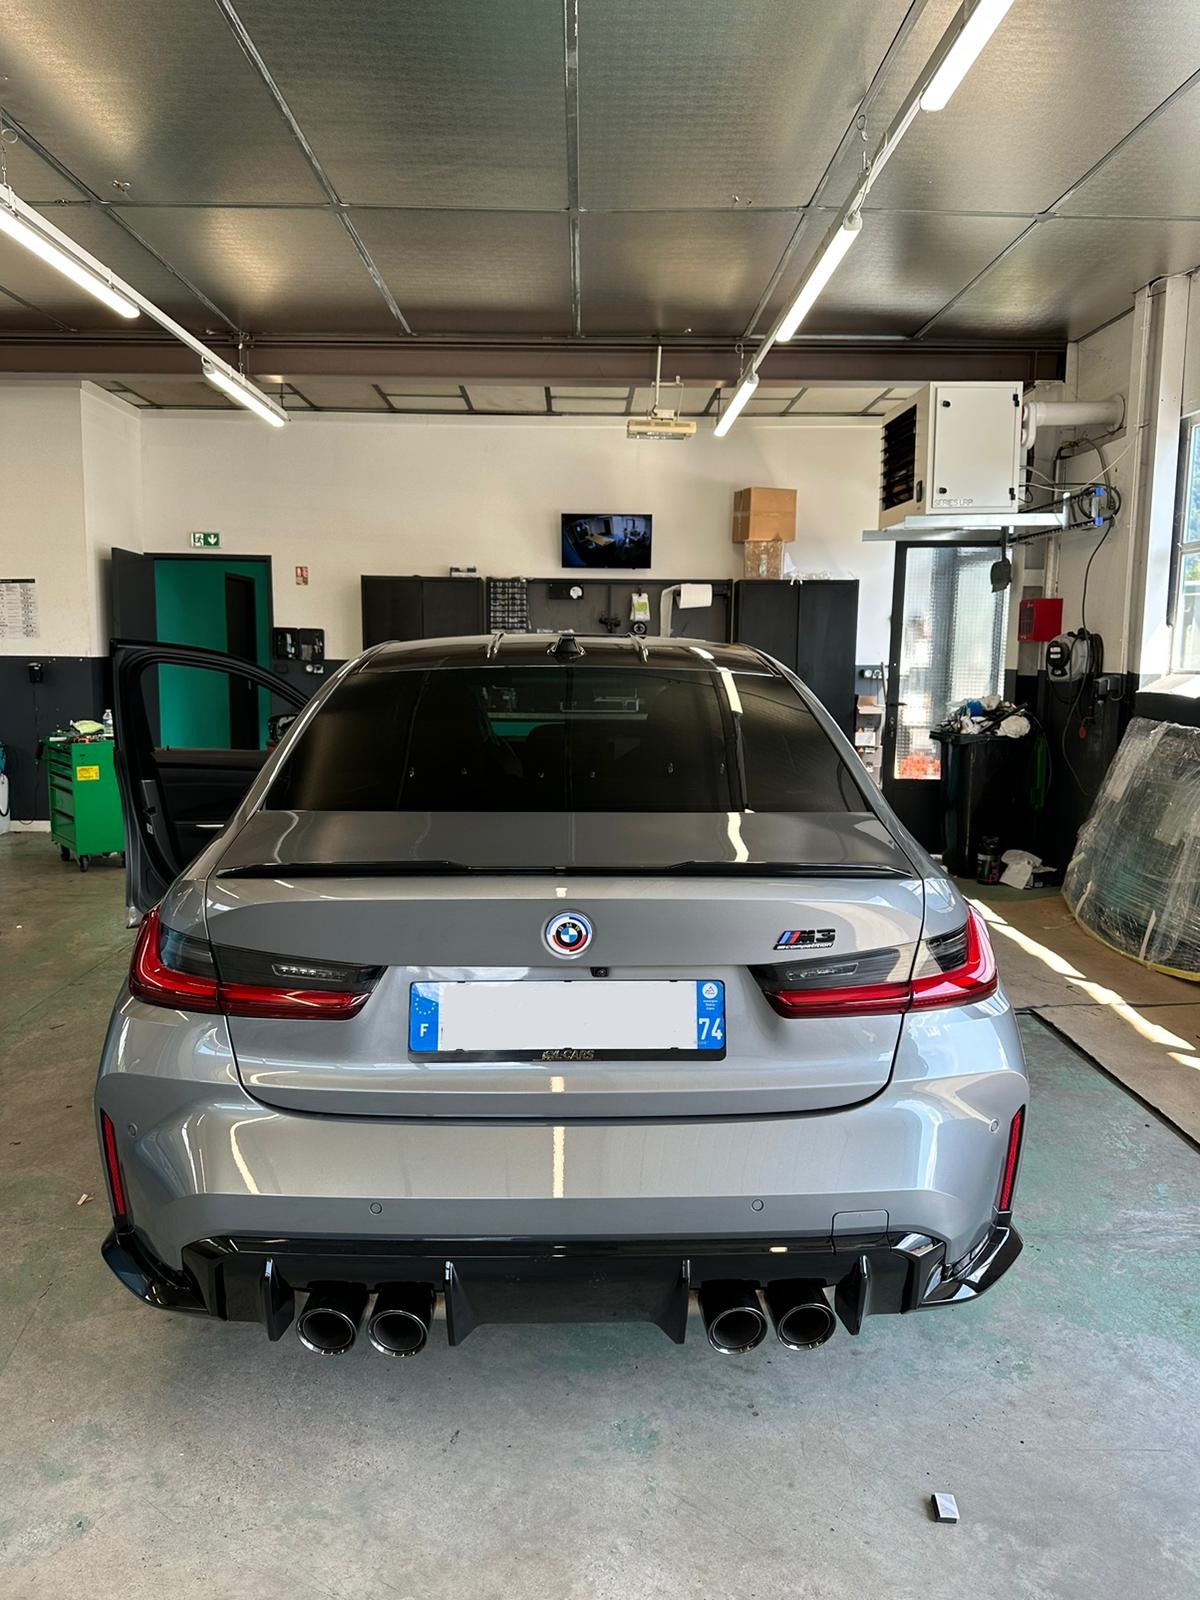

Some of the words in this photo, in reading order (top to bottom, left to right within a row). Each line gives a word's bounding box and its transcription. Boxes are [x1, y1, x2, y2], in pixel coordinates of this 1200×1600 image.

[557, 922, 582, 931] BMW
[781, 928, 836, 943] M3
[420, 1023, 429, 1037] F
[698, 1017, 723, 1040] 74
